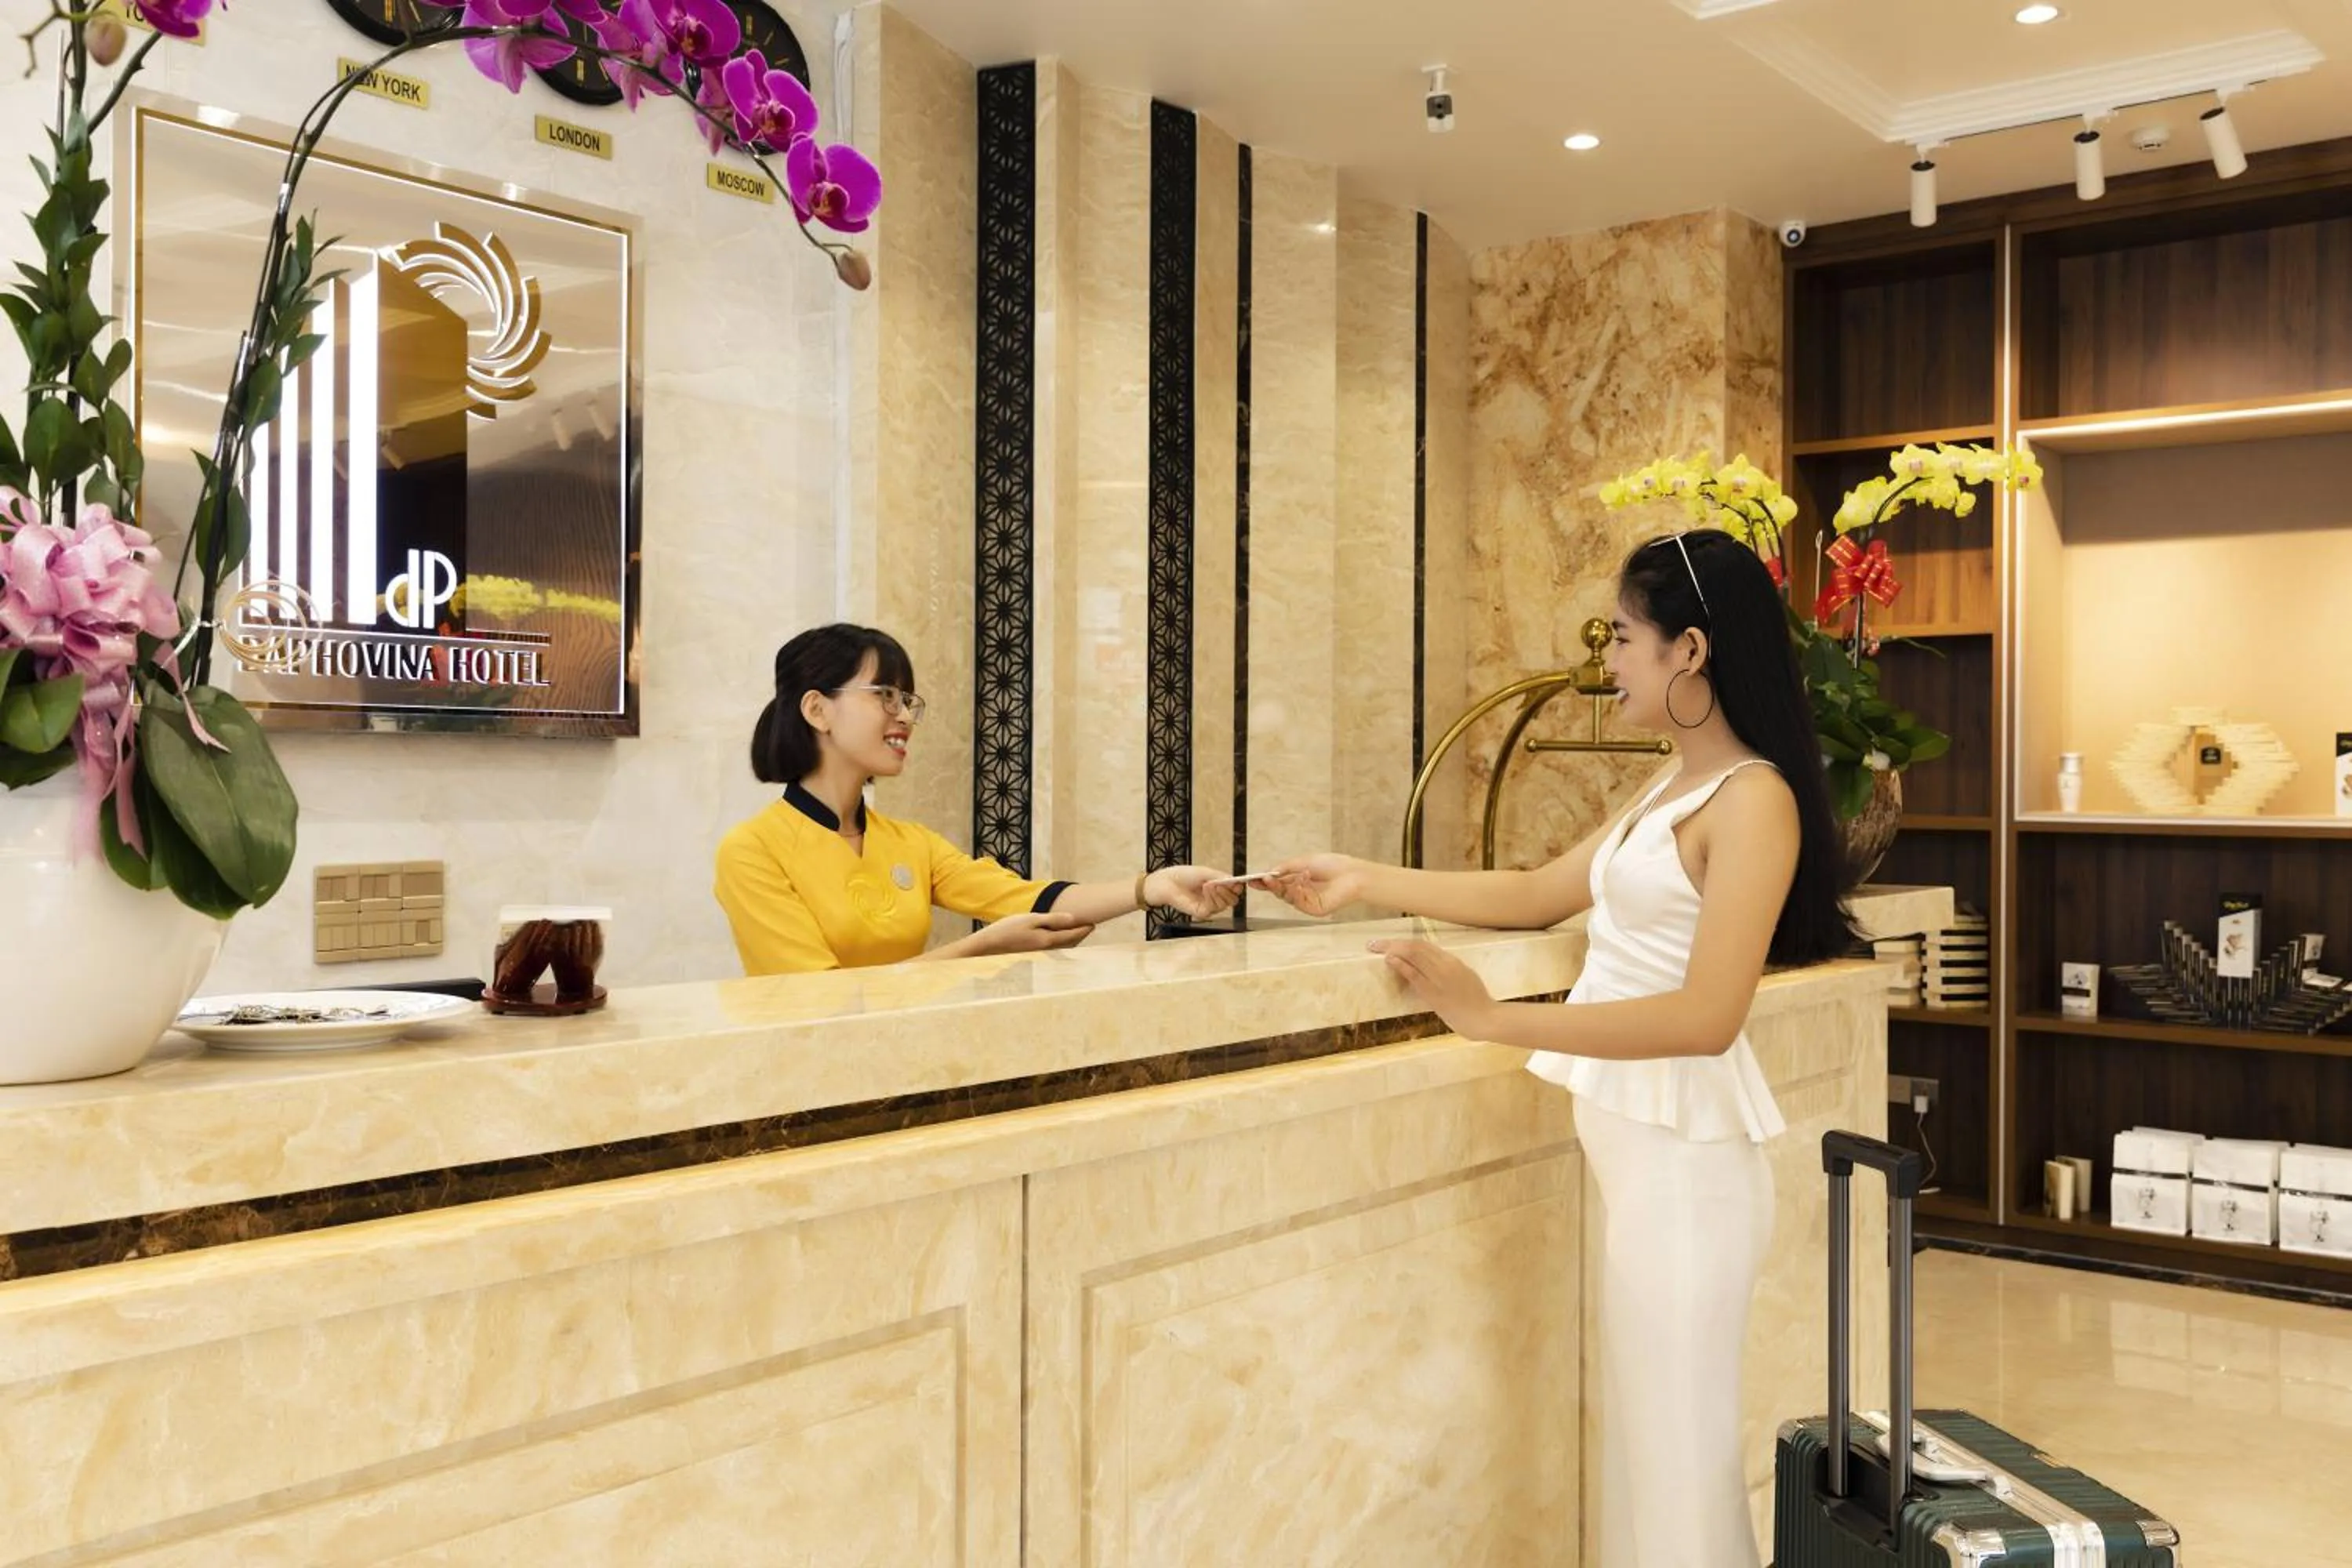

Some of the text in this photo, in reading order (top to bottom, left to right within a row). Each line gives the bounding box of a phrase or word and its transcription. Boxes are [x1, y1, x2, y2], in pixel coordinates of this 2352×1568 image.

[346, 64, 421, 102] NW YORK
[549, 123, 601, 152] LONDON
[717, 170, 765, 197] MOSCOW
[448, 645, 551, 687] HOTEL
